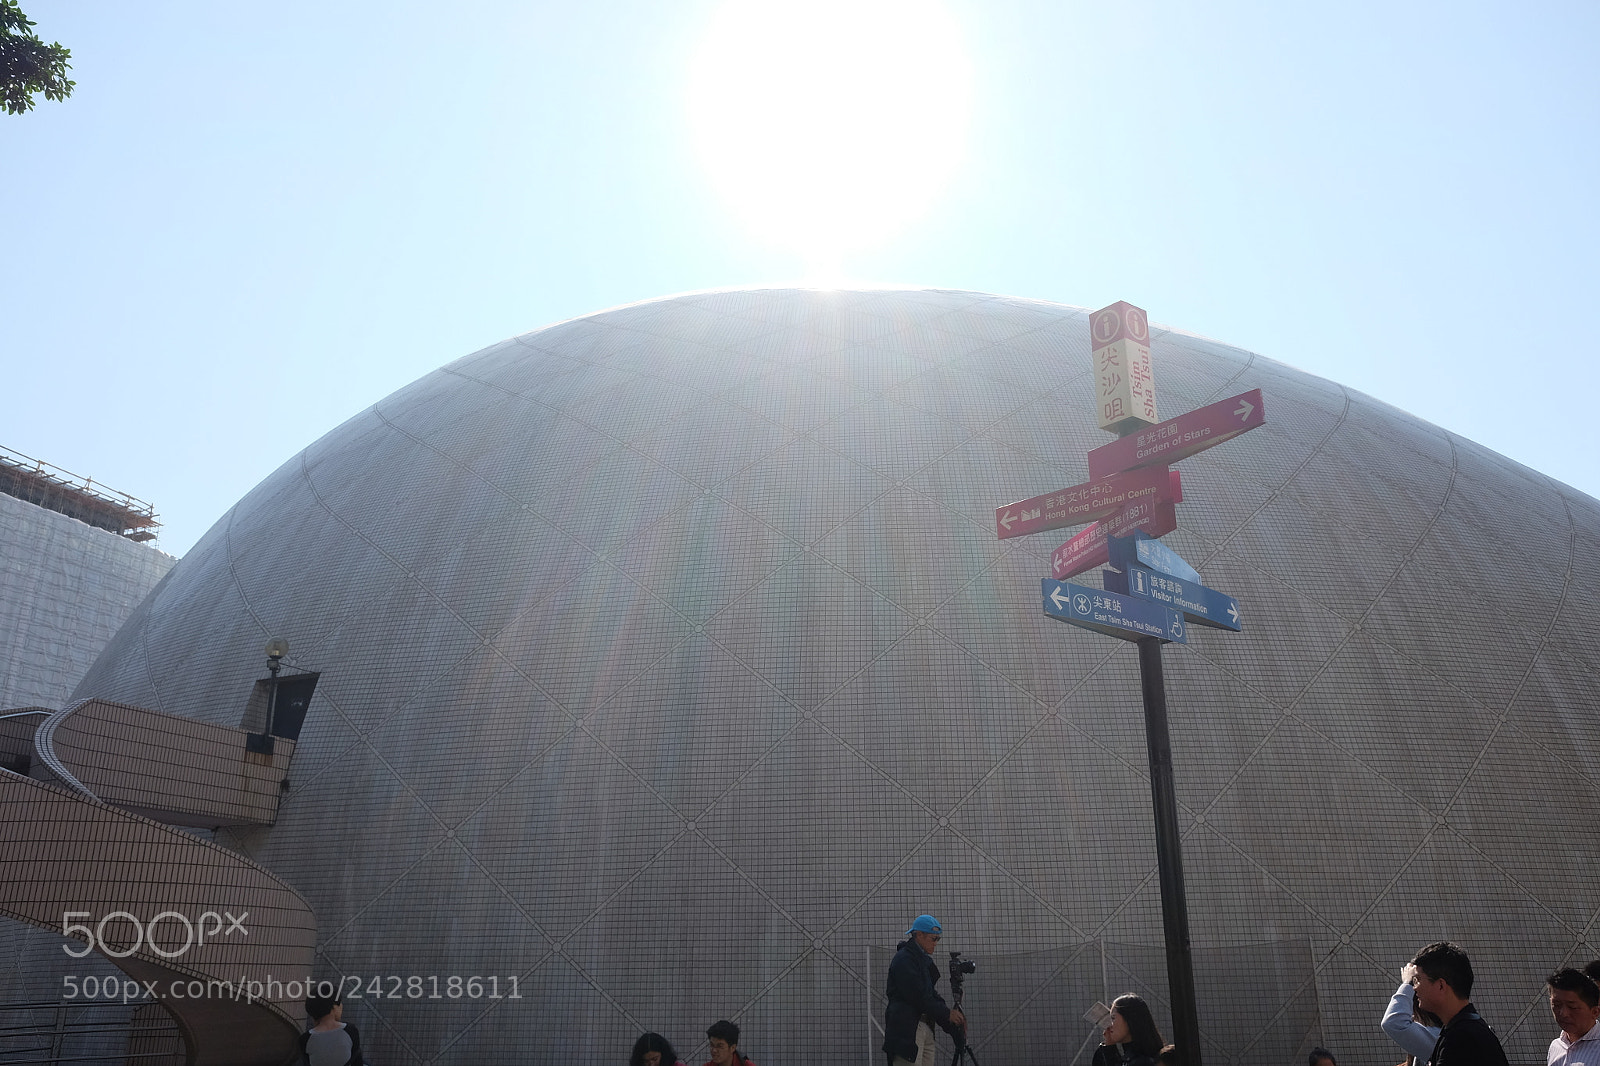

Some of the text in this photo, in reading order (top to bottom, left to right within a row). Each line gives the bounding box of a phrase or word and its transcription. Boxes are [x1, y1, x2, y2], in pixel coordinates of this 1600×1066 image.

[1101, 347, 1125, 420] 尖沙咀
[1131, 361, 1142, 398] Tsim
[1138, 348, 1155, 418] Sha Tsui
[1136, 423, 1178, 448] 星光花園
[1136, 426, 1211, 459] Garden of Stars
[1045, 483, 1113, 509] 香港文化中心
[1045, 485, 1157, 520] Hong Kong Cultural Centre
[1093, 595, 1122, 613] 尖東站
[1151, 588, 1208, 614] Visitor Information
[1094, 612, 1163, 634] East Tsim Sha Tsui Station
